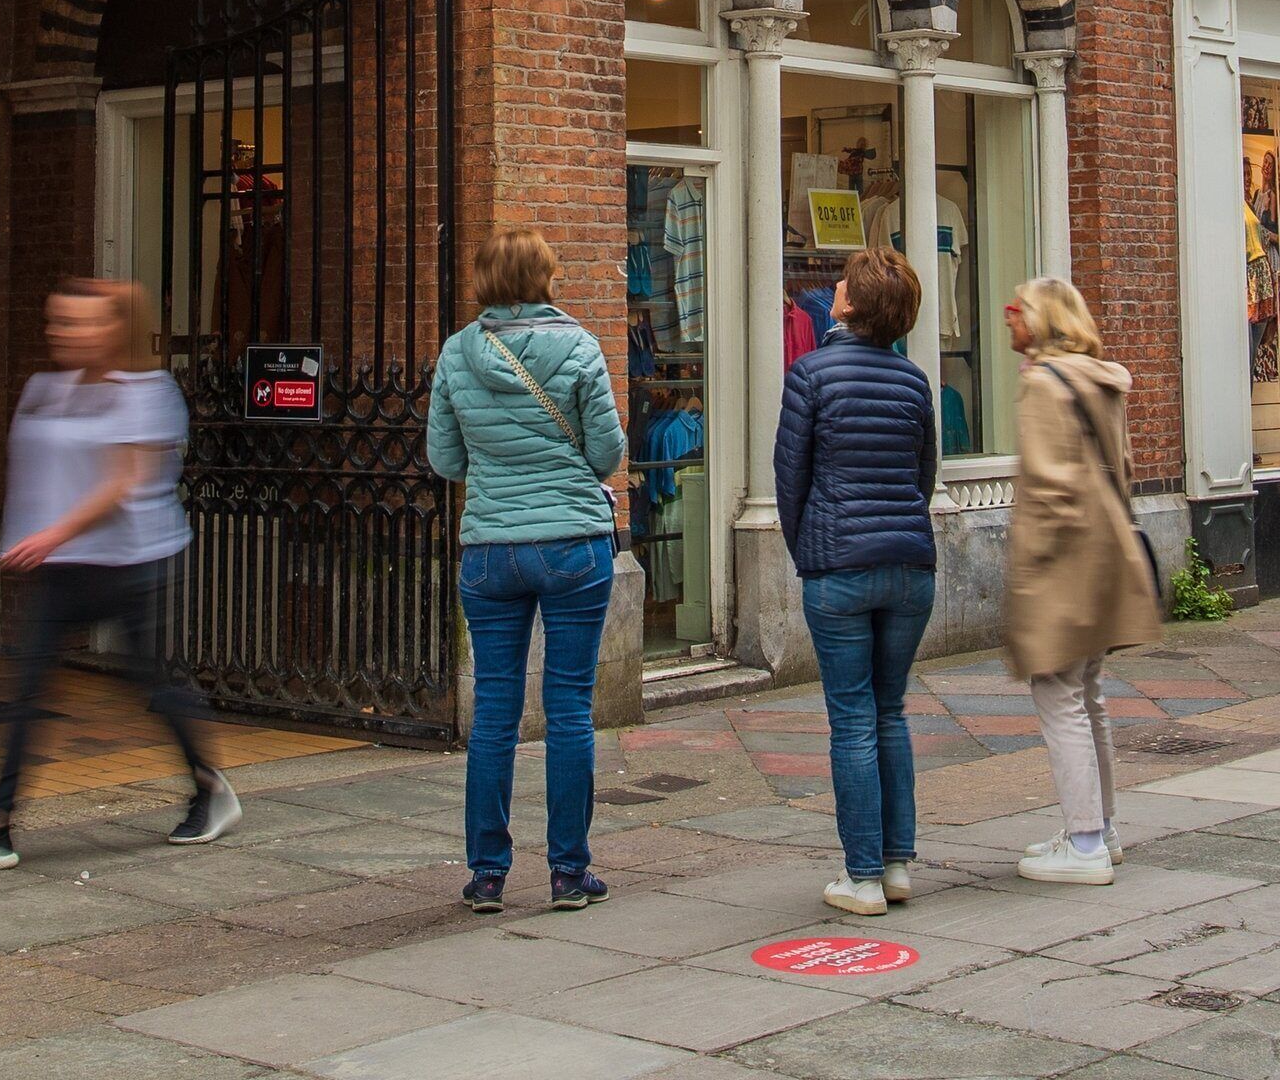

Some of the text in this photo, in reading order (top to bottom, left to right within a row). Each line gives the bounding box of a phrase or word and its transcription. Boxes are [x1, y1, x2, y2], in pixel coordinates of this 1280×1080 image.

[817, 206, 856, 222] 20% OFF
[284, 387, 295, 396] dogs
[295, 386, 312, 395] allowed
[770, 941, 832, 960] THANKS
[789, 941, 881, 971] SUPPORTING
[801, 947, 838, 960] FOR
[826, 950, 881, 967] LOCAL
